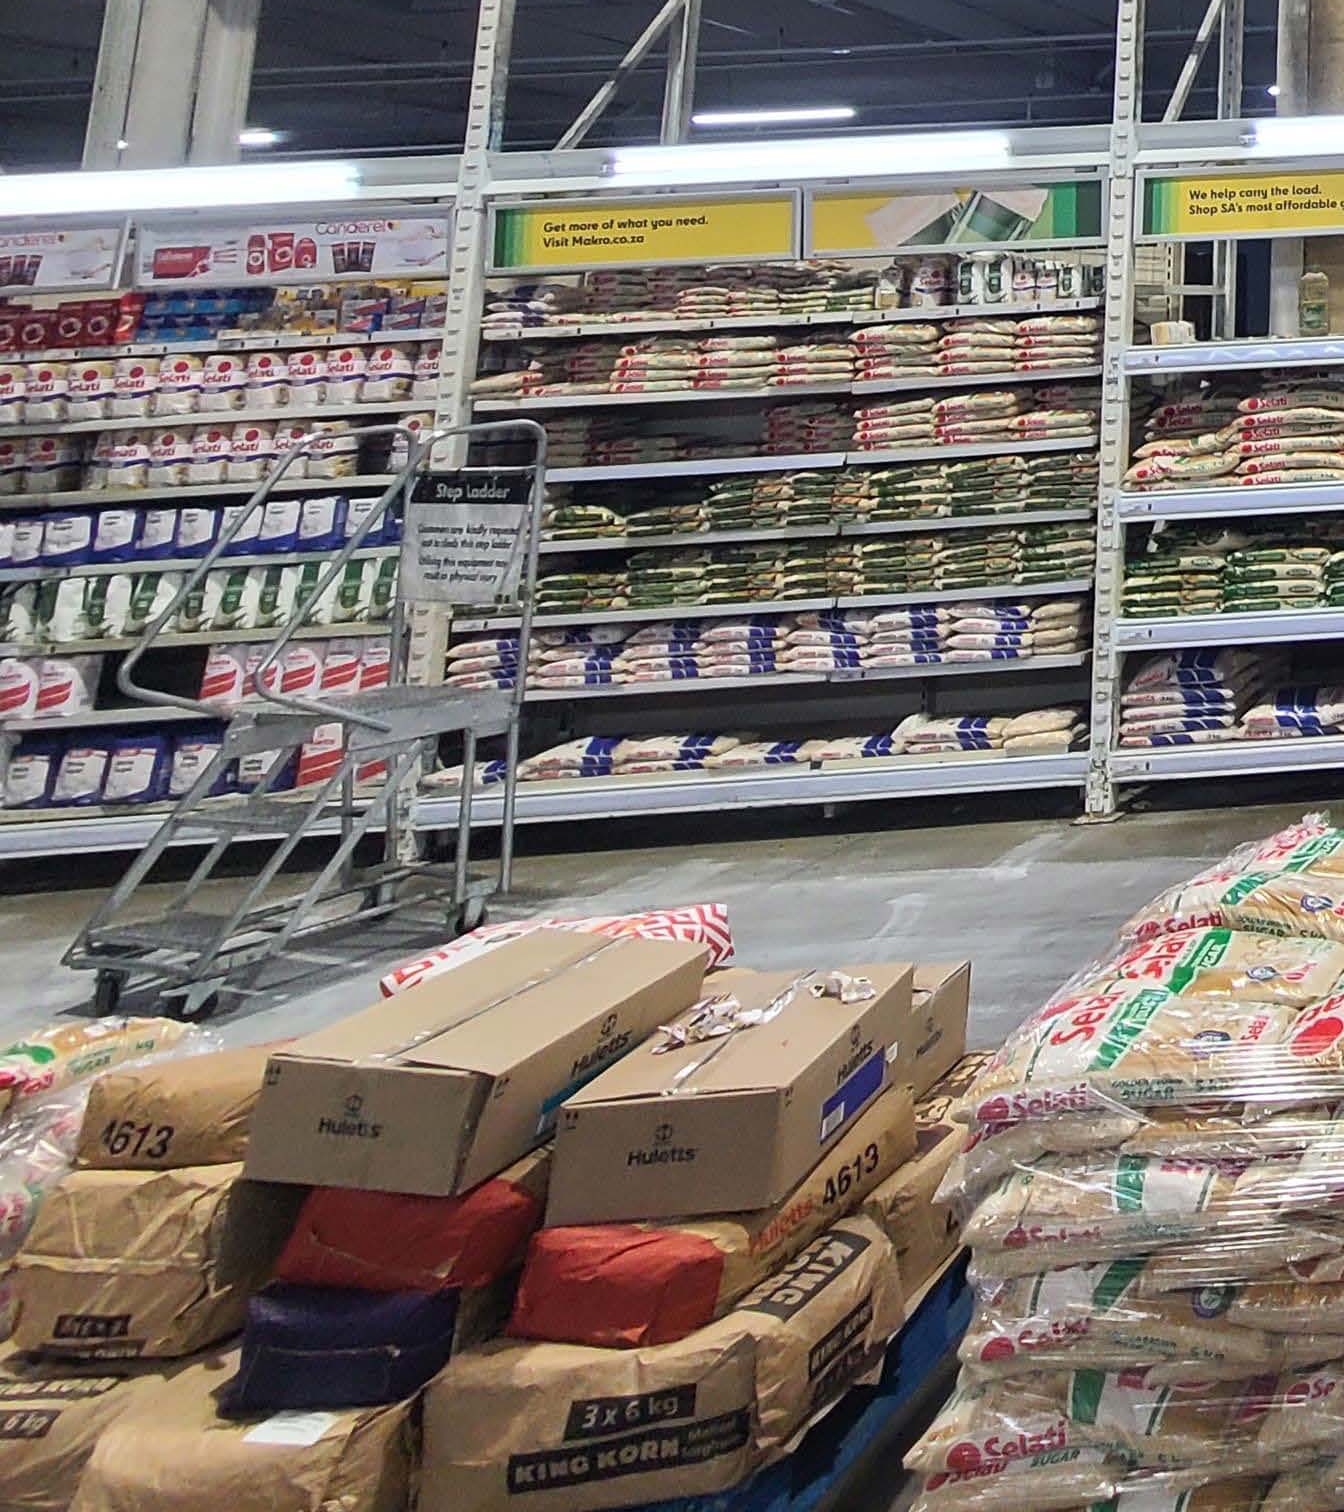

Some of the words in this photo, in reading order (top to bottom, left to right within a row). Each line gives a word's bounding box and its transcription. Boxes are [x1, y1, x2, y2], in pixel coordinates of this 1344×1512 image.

[1189, 189, 1207, 201] We
[1210, 188, 1236, 201] help
[1239, 189, 1268, 199] carry
[1270, 185, 1289, 196] the
[1292, 184, 1322, 196] load.
[1189, 204, 1218, 216] Shop
[1220, 202, 1243, 214] SA's
[1246, 202, 1273, 213] most
[1275, 198, 1337, 211] affordable
[543, 221, 566, 233] Get
[569, 222, 598, 232] more
[601, 218, 614, 230] of
[617, 218, 648, 229] what
[651, 219, 673, 230] you
[675, 215, 709, 226] need.
[543, 235, 568, 248] Visit
[572, 234, 645, 246] Makro.co.za
[435, 482, 463, 502] Step
[1160, 911, 1224, 933] Selati
[571, 1029, 634, 1078] Huletts
[1011, 1081, 1089, 1116] Selati
[317, 1117, 384, 1139] Huletts
[627, 1147, 699, 1168] Huletts
[823, 1143, 880, 1206] 4613
[581, 1404, 599, 1430] 3
[602, 1407, 619, 1427] x
[625, 1399, 642, 1419] 6
[648, 1396, 680, 1416] kg
[984, 1417, 1067, 1458] Selati
[514, 1454, 590, 1485] KING
[596, 1439, 681, 1469] KORN
[1029, 1448, 1082, 1470] SUGAR
